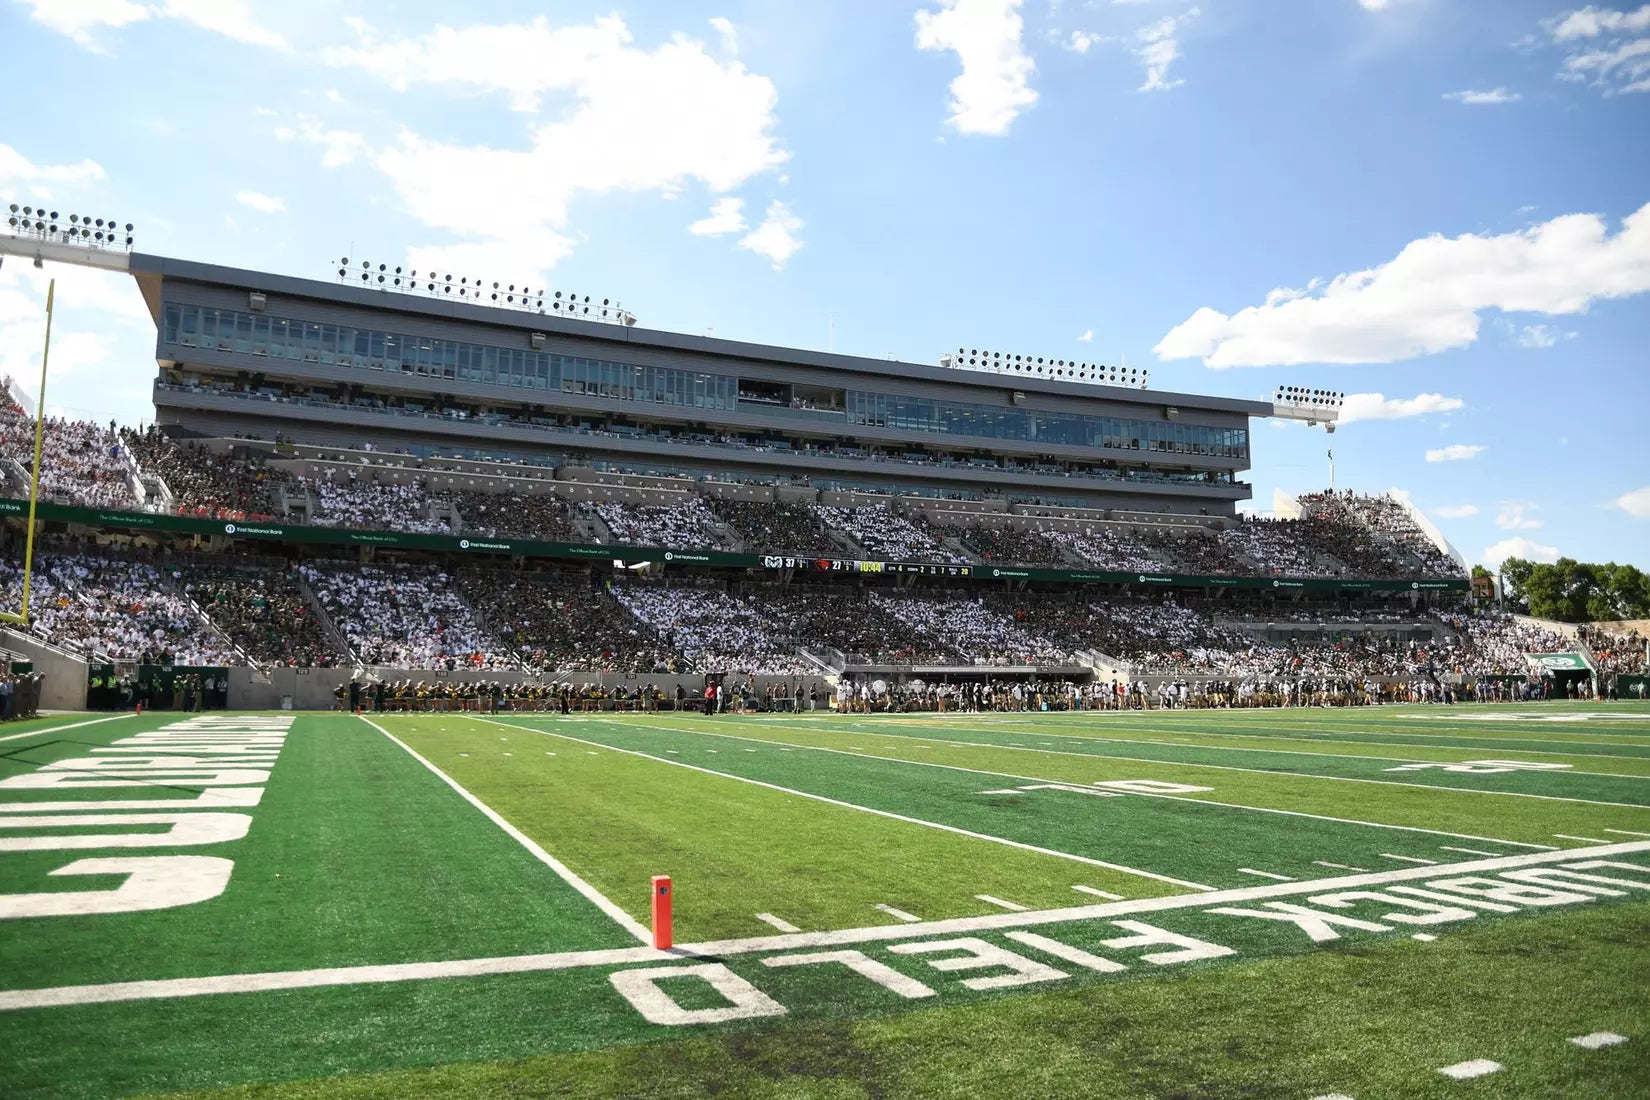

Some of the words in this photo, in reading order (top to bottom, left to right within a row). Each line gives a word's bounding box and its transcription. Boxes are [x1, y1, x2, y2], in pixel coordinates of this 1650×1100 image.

[785, 558, 795, 569] 37
[832, 560, 842, 571] 27
[859, 562, 882, 573] 10:44
[1202, 859, 1650, 942] LUBICK
[608, 919, 1236, 1025] FIELD
